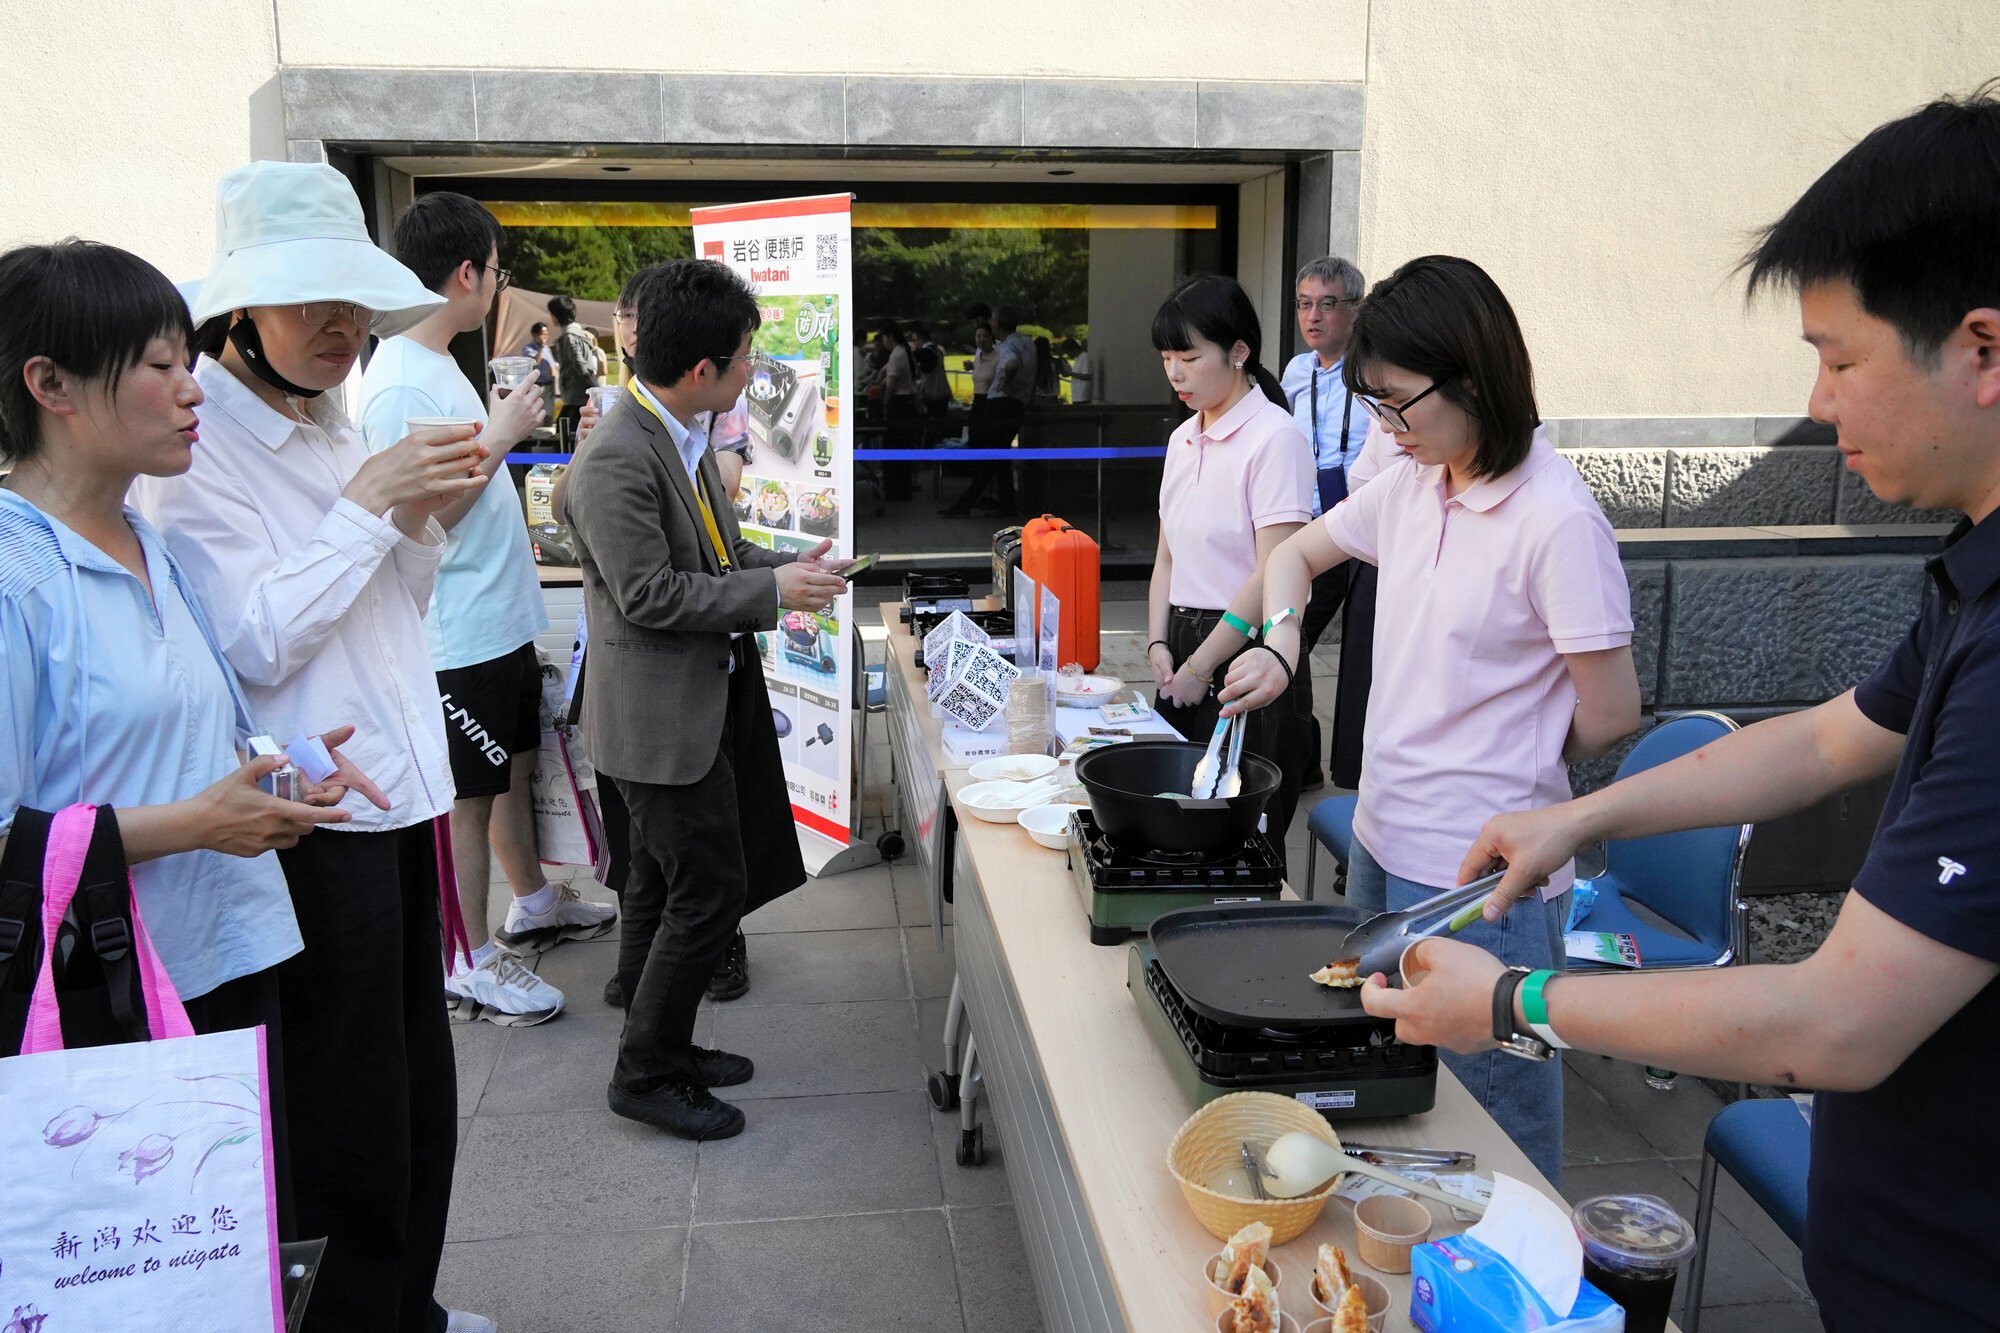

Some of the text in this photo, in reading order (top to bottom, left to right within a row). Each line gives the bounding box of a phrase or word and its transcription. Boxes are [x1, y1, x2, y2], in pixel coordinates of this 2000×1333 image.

[733, 239, 760, 262] 岩谷
[765, 236, 804, 260] 便携炉
[750, 266, 790, 282] Iwatani
[54, 1242, 241, 1289] welcome to niigata
